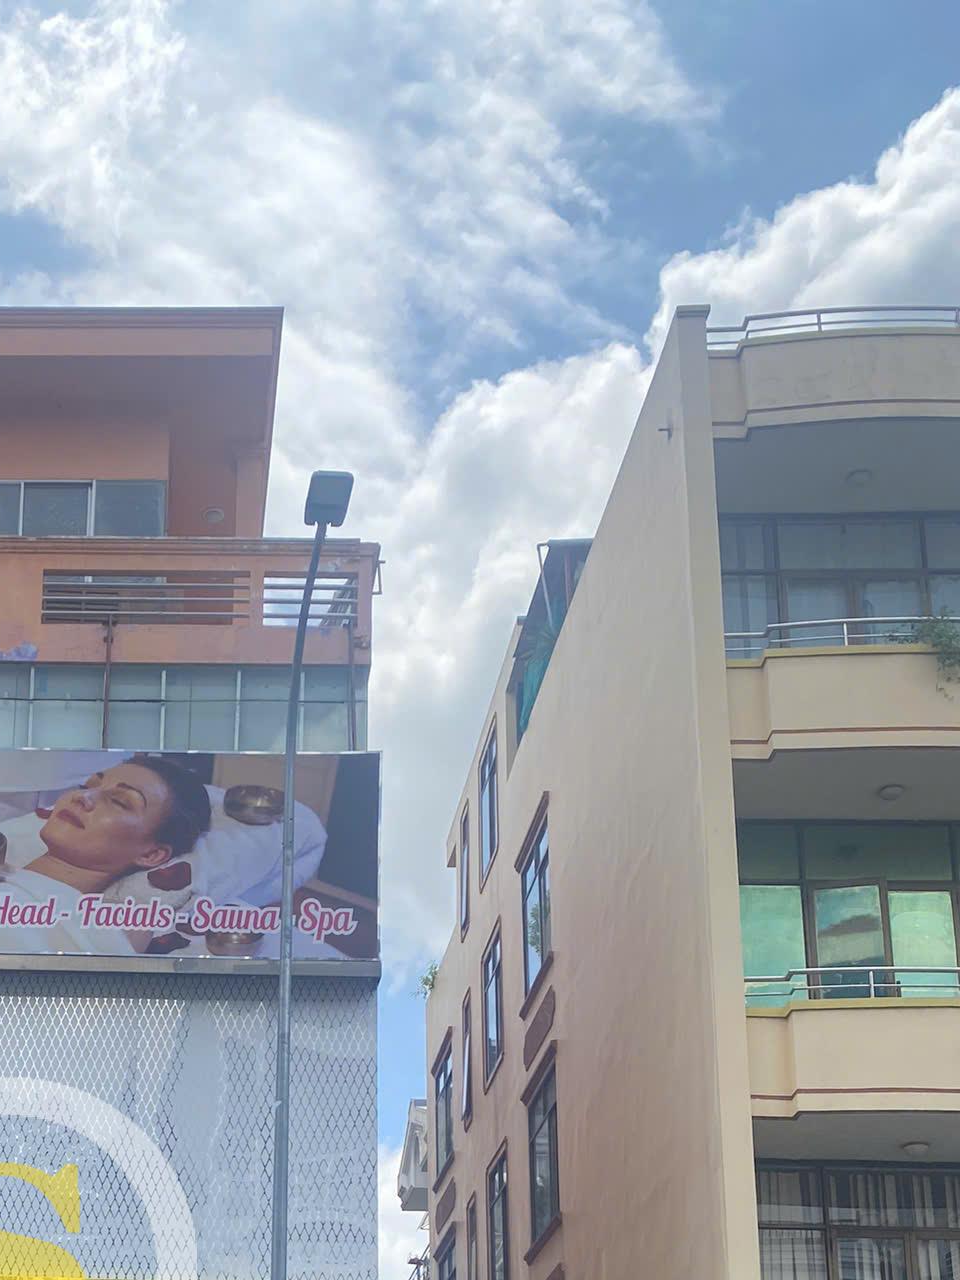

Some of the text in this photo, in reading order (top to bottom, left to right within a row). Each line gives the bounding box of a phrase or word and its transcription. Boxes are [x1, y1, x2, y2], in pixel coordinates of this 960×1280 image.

[78, 896, 172, 929] Facials
[193, 899, 280, 932] Sauna
[299, 900, 355, 941] Spa
